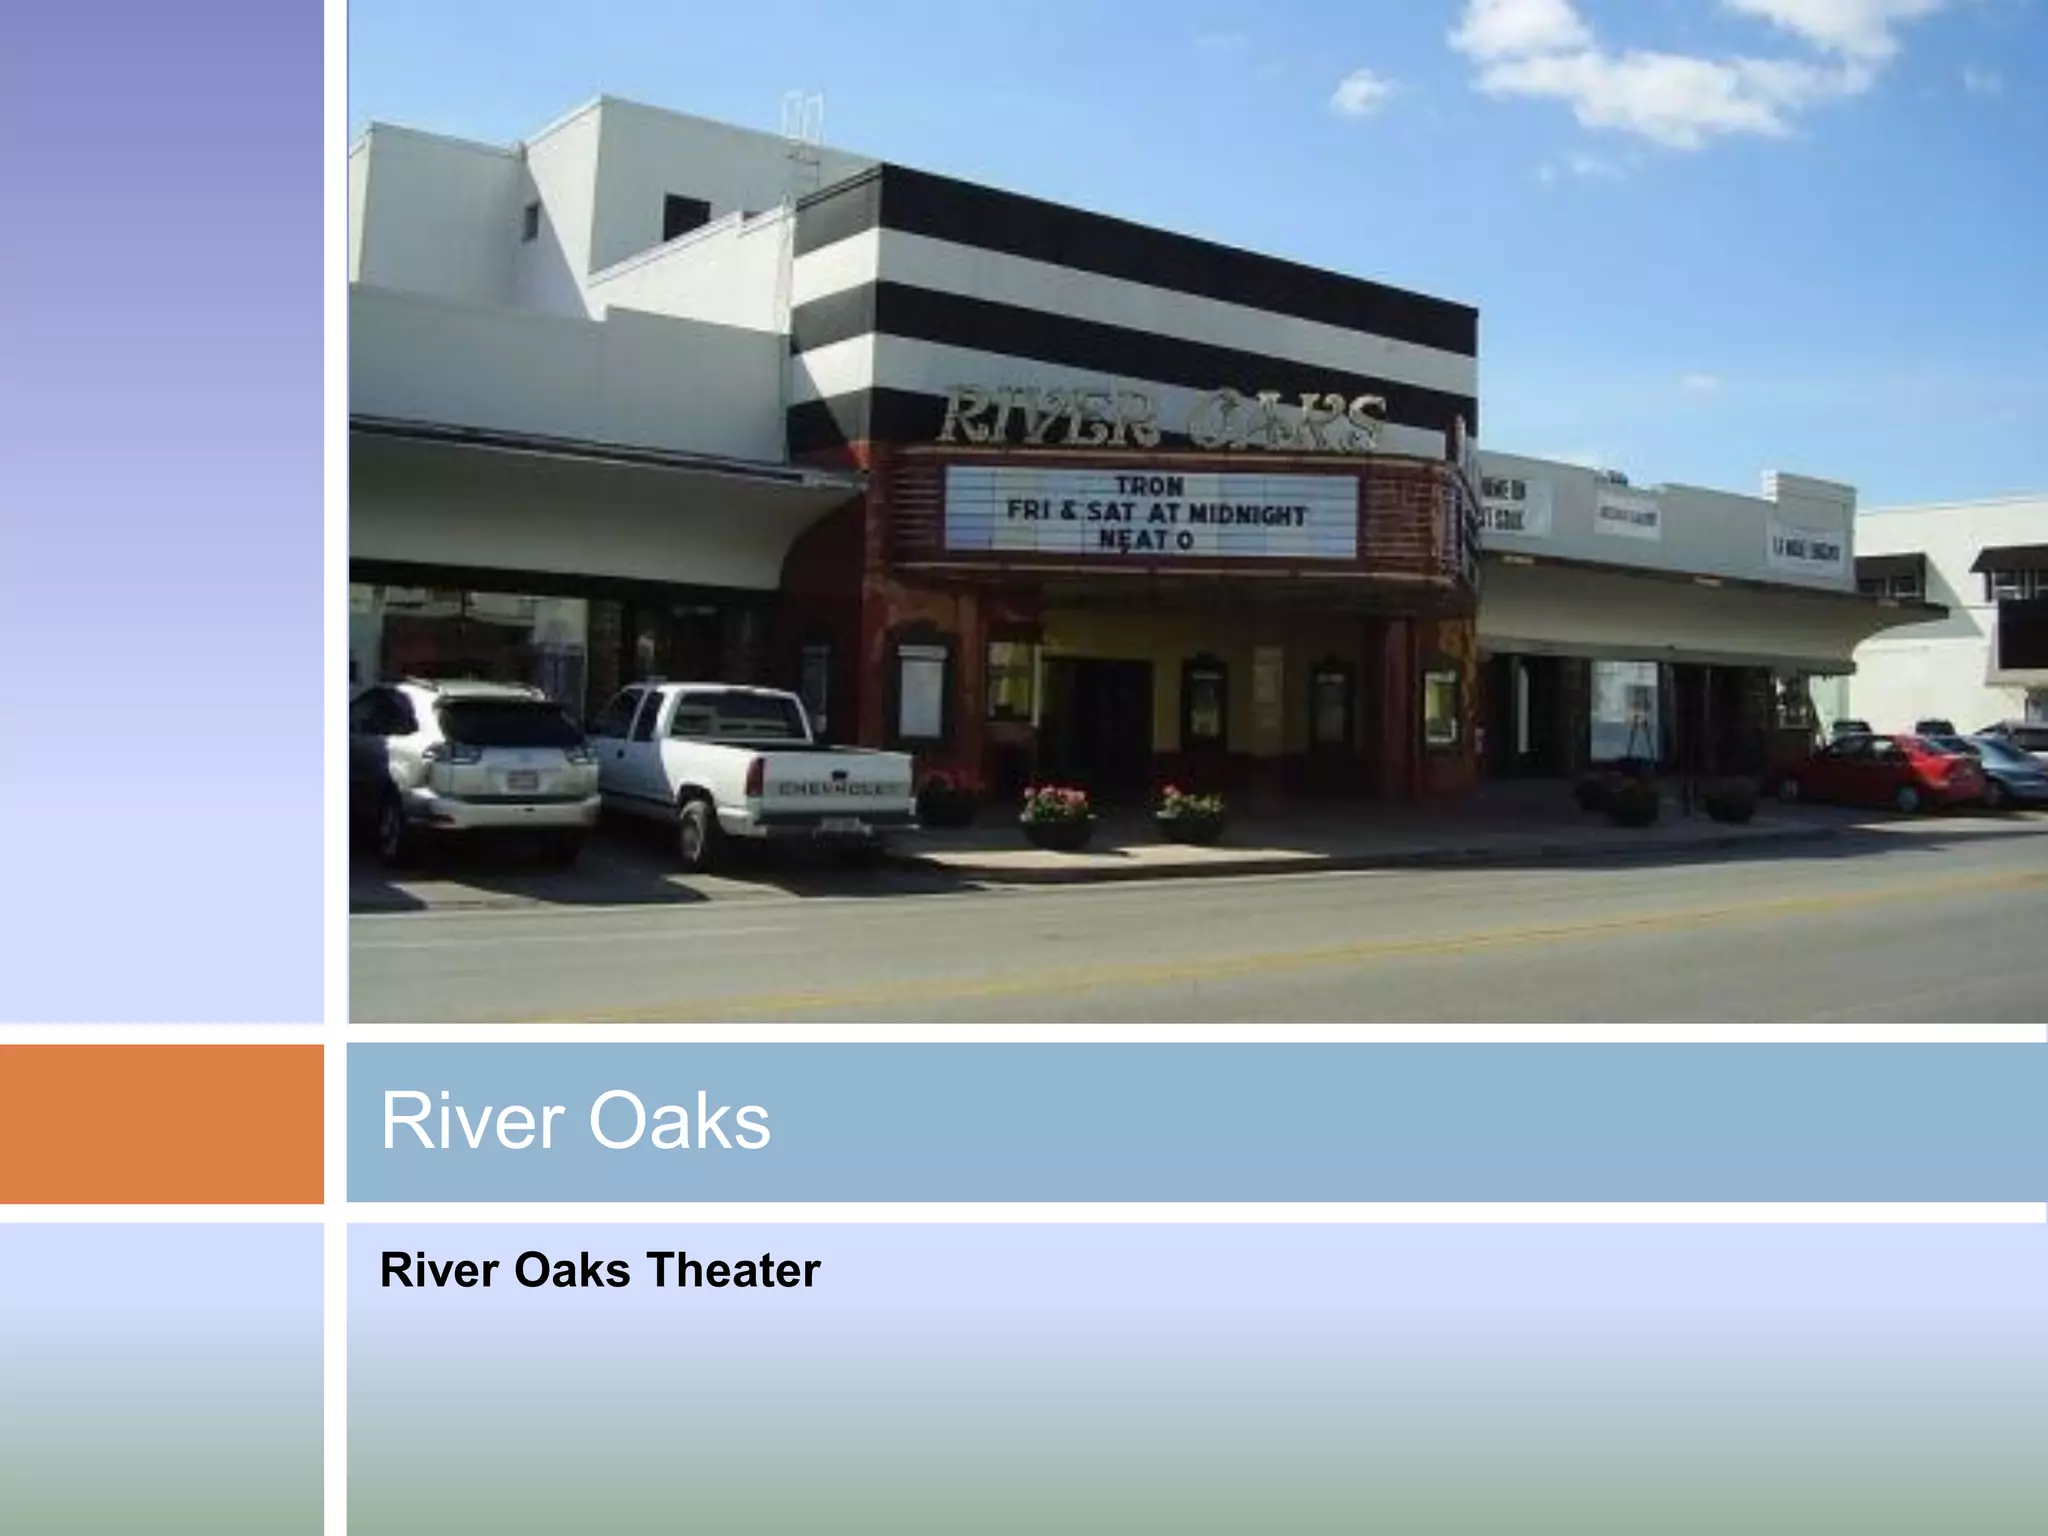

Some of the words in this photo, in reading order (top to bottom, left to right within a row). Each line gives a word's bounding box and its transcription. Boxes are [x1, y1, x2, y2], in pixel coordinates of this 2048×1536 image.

[936, 384, 1161, 447] RIVER
[1187, 387, 1390, 453] OAKS
[1114, 476, 1185, 497] TRON
[1007, 500, 1050, 521] FRI
[1059, 501, 1078, 521] &
[1087, 502, 1134, 522] SAT
[1147, 503, 1182, 524] AT
[1189, 504, 1309, 527] MIDNIGHT
[1099, 529, 1166, 552] NEAT
